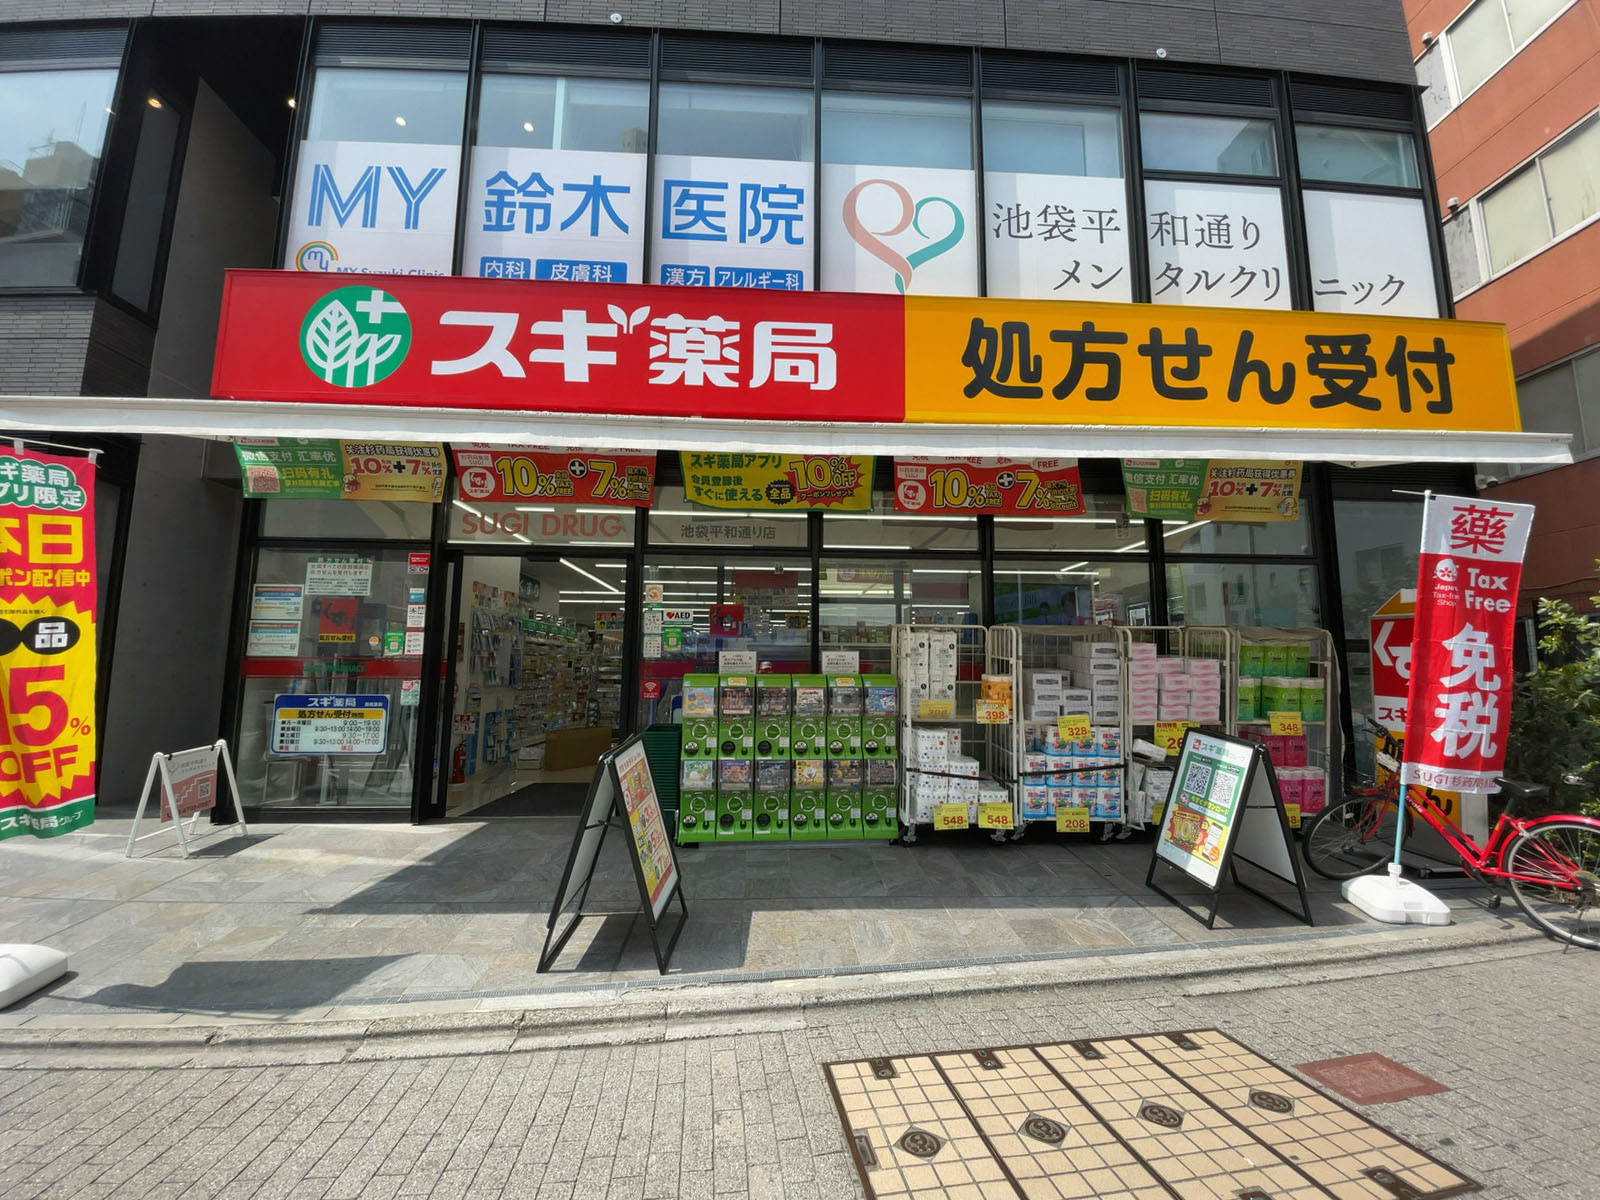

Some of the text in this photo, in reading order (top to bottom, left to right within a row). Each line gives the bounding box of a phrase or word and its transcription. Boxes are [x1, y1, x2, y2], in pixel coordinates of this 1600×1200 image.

[307, 163, 806, 246] MY 鈴木医院
[992, 202, 1262, 252] 池袋平和通り
[484, 262, 527, 280] 内科
[550, 263, 613, 283] 皮膚科
[665, 267, 704, 286] 漢方
[717, 270, 800, 291] アレルギー科
[1051, 260, 1406, 307] メンタルクリニック
[431, 306, 838, 392] スギ薬局
[961, 317, 1456, 414] 処方せん受付
[690, 453, 783, 469] スギ薬局アプリ
[497, 458, 556, 496] 10%
[588, 460, 628, 498] 7%
[691, 474, 743, 487] 会員登録後
[832, 470, 857, 488] OFF
[693, 485, 763, 502] すぐに使える
[769, 488, 792, 501] 全品
[930, 469, 1050, 509] 10% 7%
[461, 512, 622, 538] SUGI DRUG
[680, 523, 777, 541] 池袋平和通り店
[1450, 504, 1514, 555] 藥
[1467, 567, 1508, 591] Tax
[1464, 589, 1512, 614] Free
[674, 611, 691, 619] AED
[34, 621, 69, 650] 品
[1430, 621, 1502, 760] 免税
[307, 696, 357, 707] スギ薬局
[984, 710, 1006, 720] 398
[1067, 726, 1088, 737] 328
[1279, 723, 1298, 732] 348
[0, 744, 79, 783] OFF
[1413, 769, 1449, 785] SUGI
[943, 815, 965, 826] 548
[987, 815, 1009, 826] 548
[1065, 819, 1087, 829] 208
